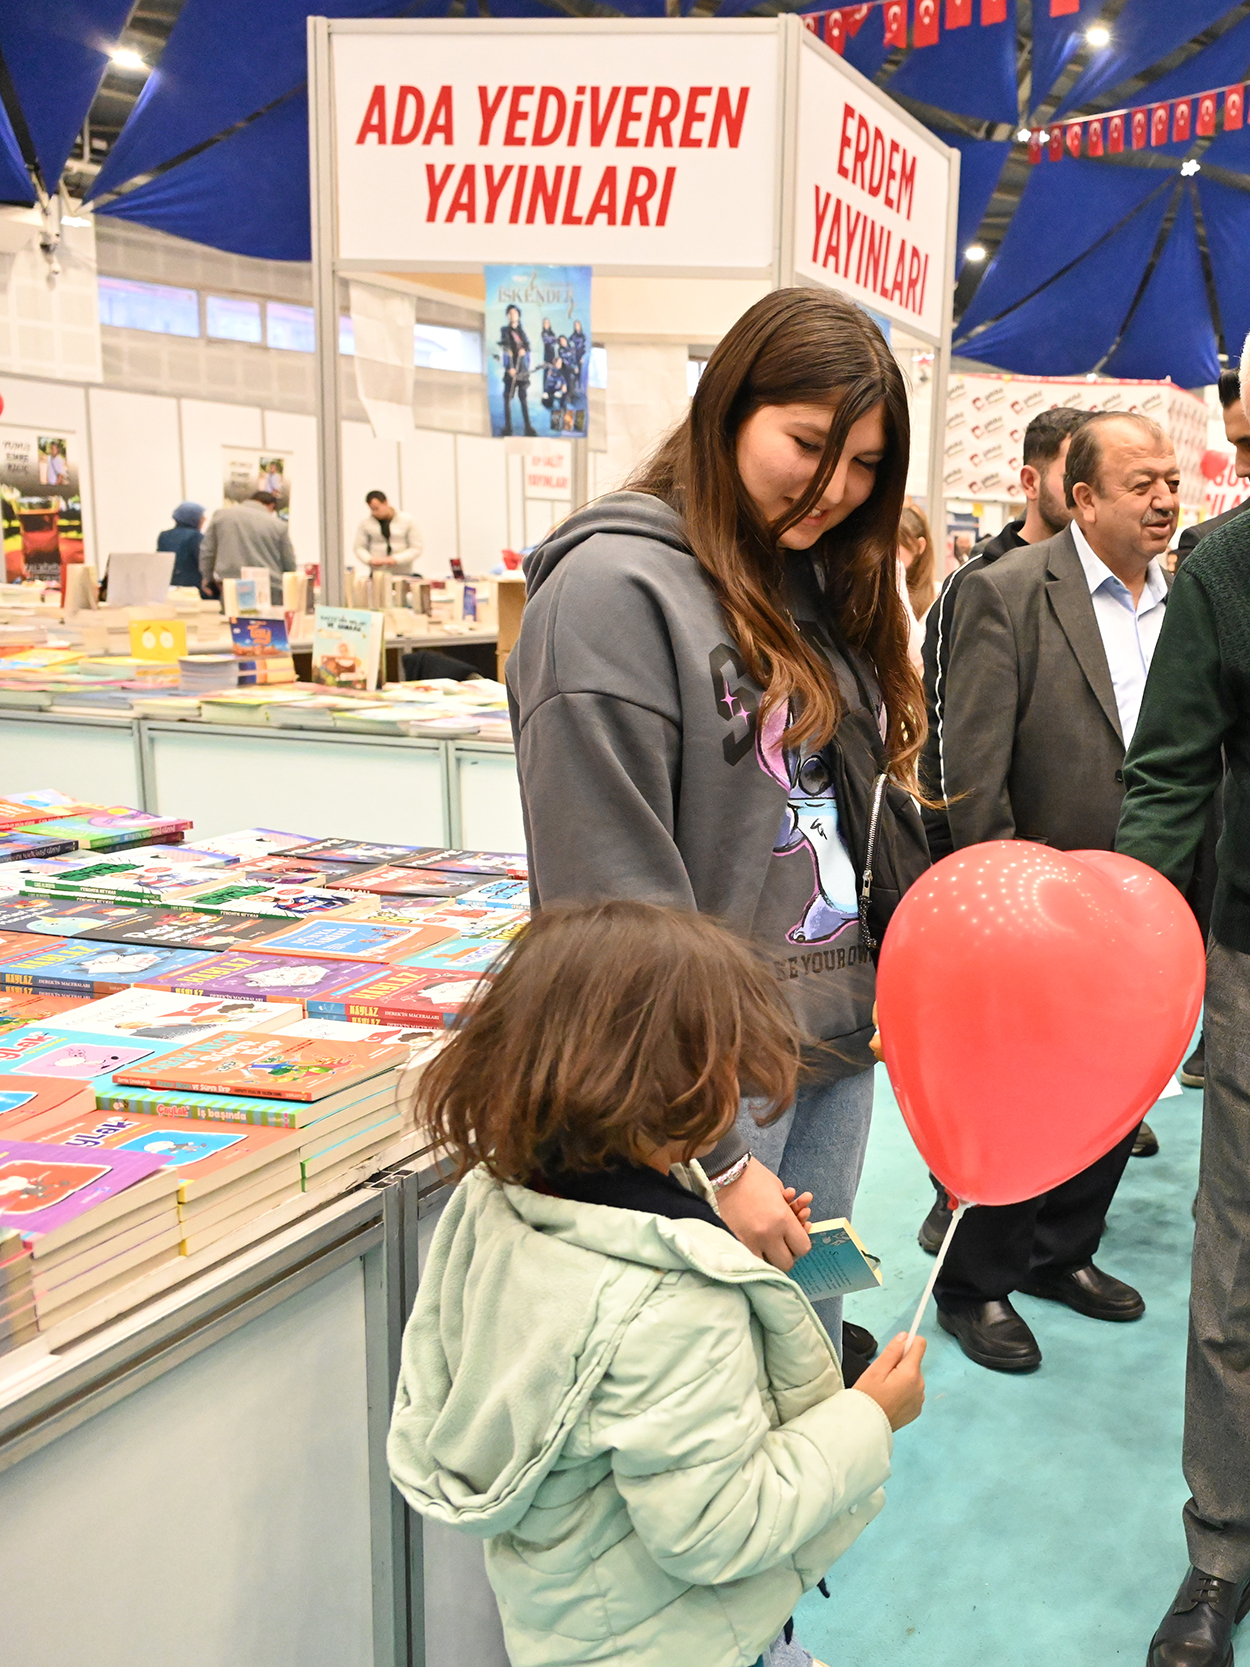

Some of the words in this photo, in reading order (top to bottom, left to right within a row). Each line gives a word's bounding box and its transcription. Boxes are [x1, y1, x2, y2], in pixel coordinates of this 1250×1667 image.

[355, 84, 455, 146] ADA
[837, 101, 917, 221] ERDEM
[424, 162, 678, 227] YAYINLARI
[811, 183, 929, 317] YAYINLARI
[9, 945, 101, 970] HAYLAZ
[176, 957, 264, 984] HAYLAZ
[800, 947, 846, 976] YOUR
[5, 973, 33, 986] HAYLAZ
[56, 980, 91, 989] MACERALARI
[175, 987, 204, 997] HAYLAZ
[348, 971, 428, 1001] HAYLAZ
[349, 1004, 379, 1017] HAYLAZ
[384, 1010, 408, 1018] DEREK'İN
[408, 1012, 440, 1021] MACERALARI
[208, 1109, 247, 1121] başında
[65, 1119, 137, 1148] yLak
